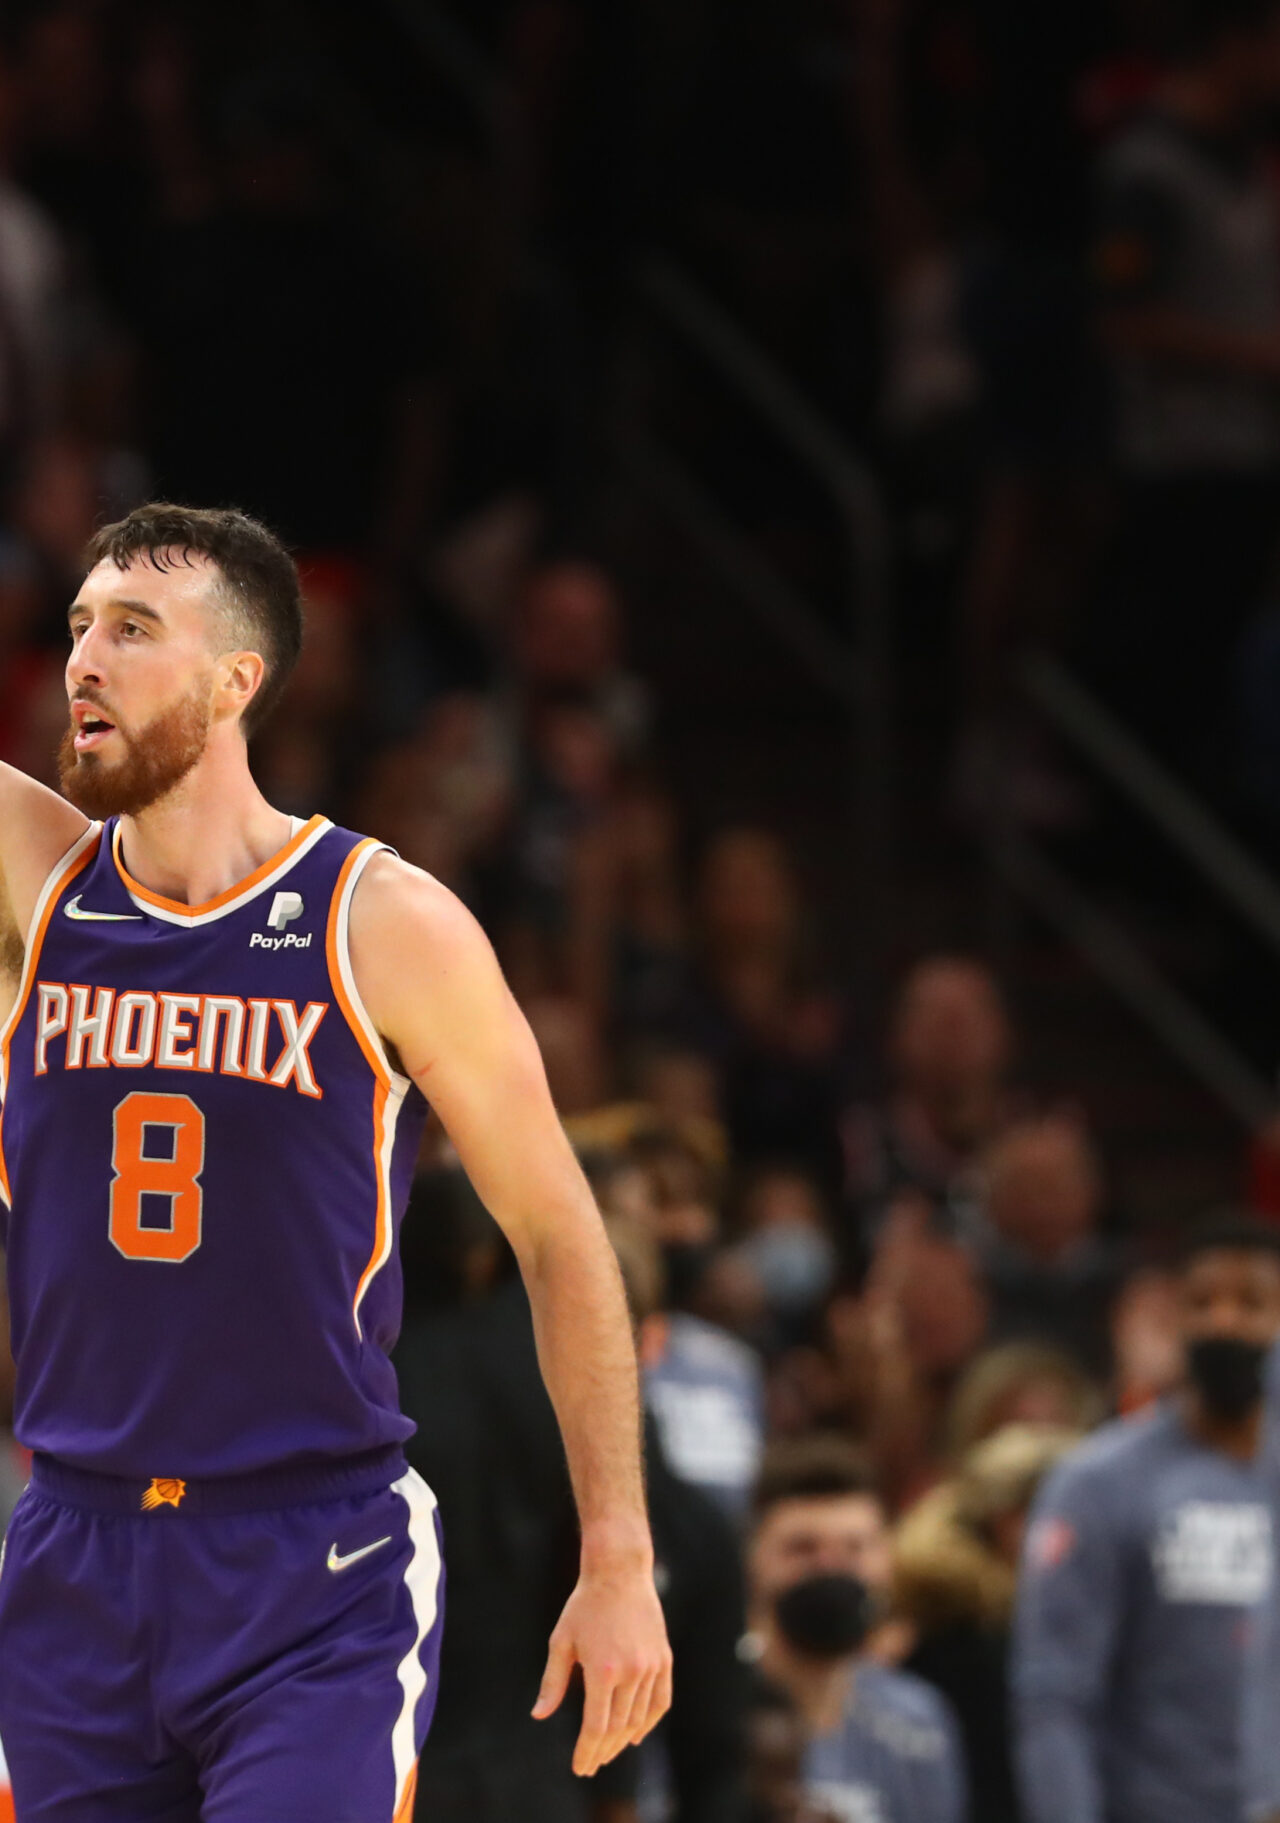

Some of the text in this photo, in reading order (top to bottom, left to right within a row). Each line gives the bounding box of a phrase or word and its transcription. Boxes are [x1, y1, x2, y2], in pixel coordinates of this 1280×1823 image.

[249, 932, 312, 951] PayPal
[34, 980, 329, 1099] PHOENIX
[108, 1091, 205, 1263] 8
